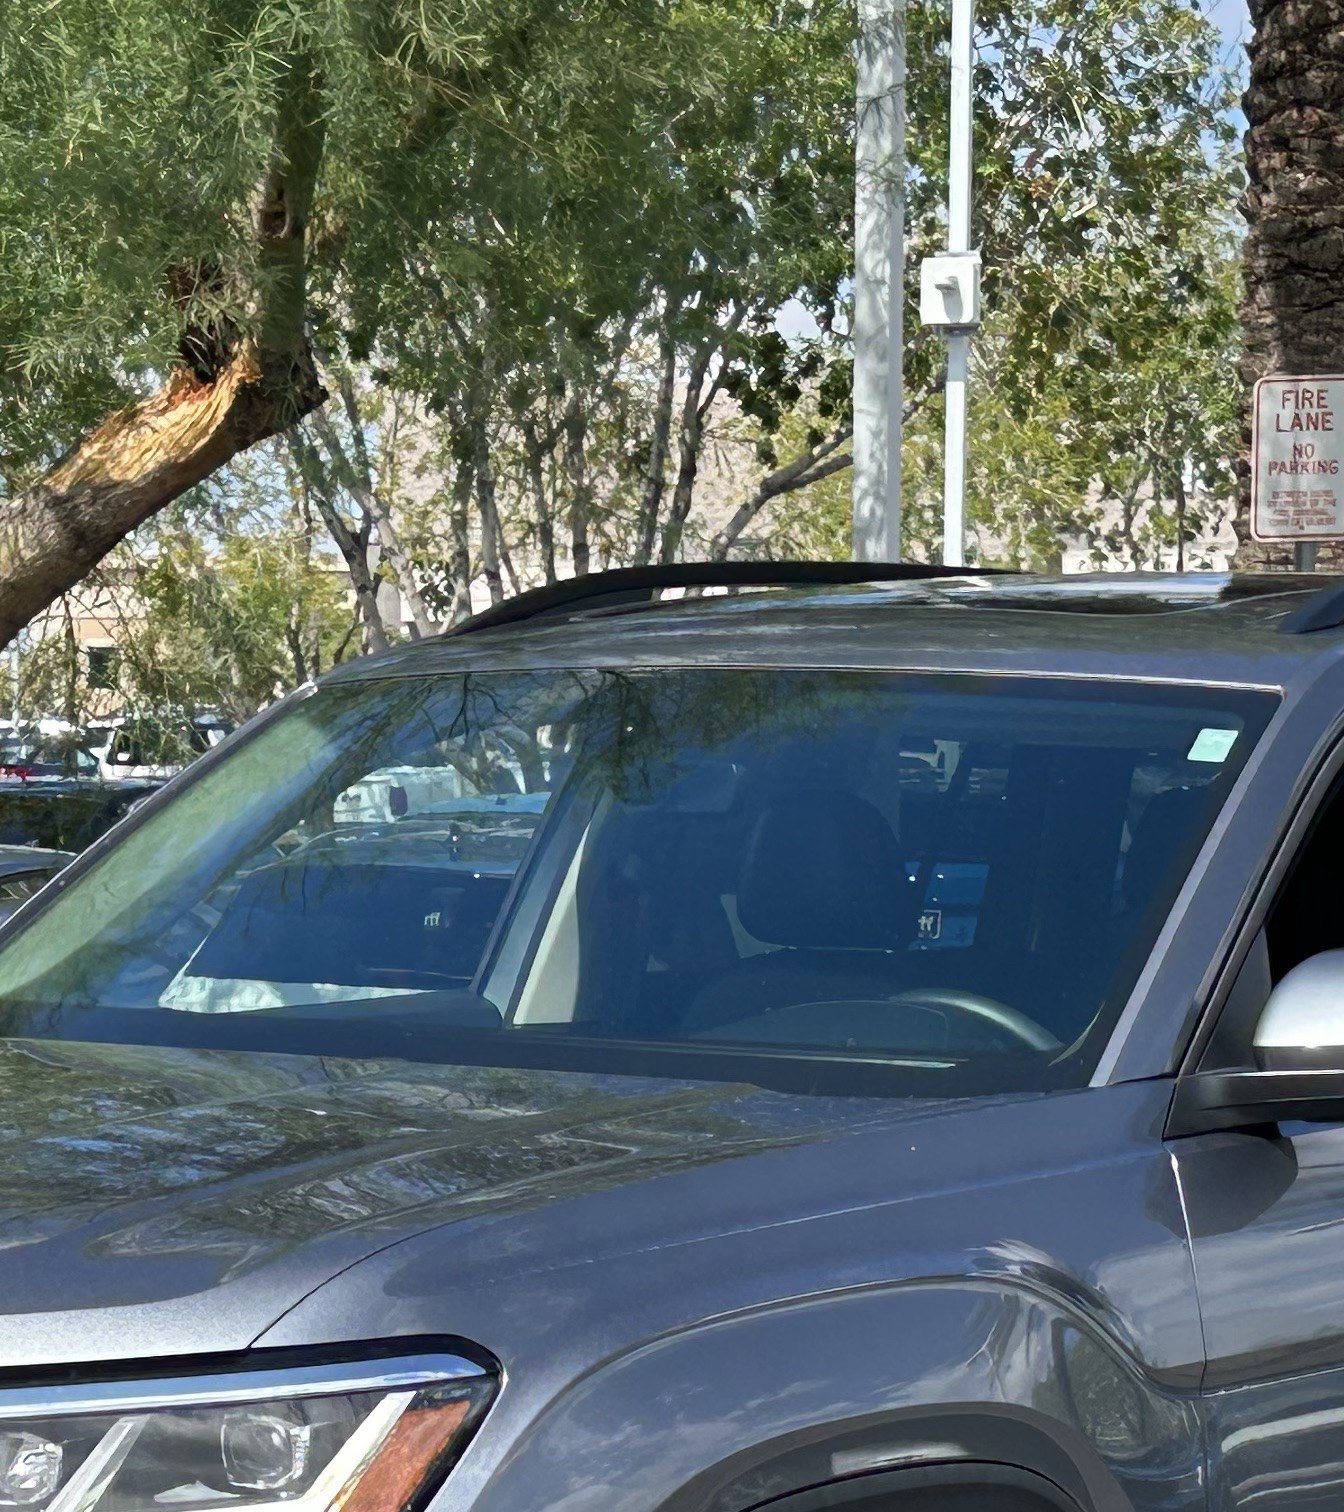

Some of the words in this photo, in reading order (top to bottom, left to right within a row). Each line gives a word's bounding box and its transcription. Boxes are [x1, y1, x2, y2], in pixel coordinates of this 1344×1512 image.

[1282, 388, 1329, 410] FIRE
[1275, 411, 1334, 432] LANE
[1292, 443, 1315, 460] NO
[1268, 459, 1340, 476] PARKING
